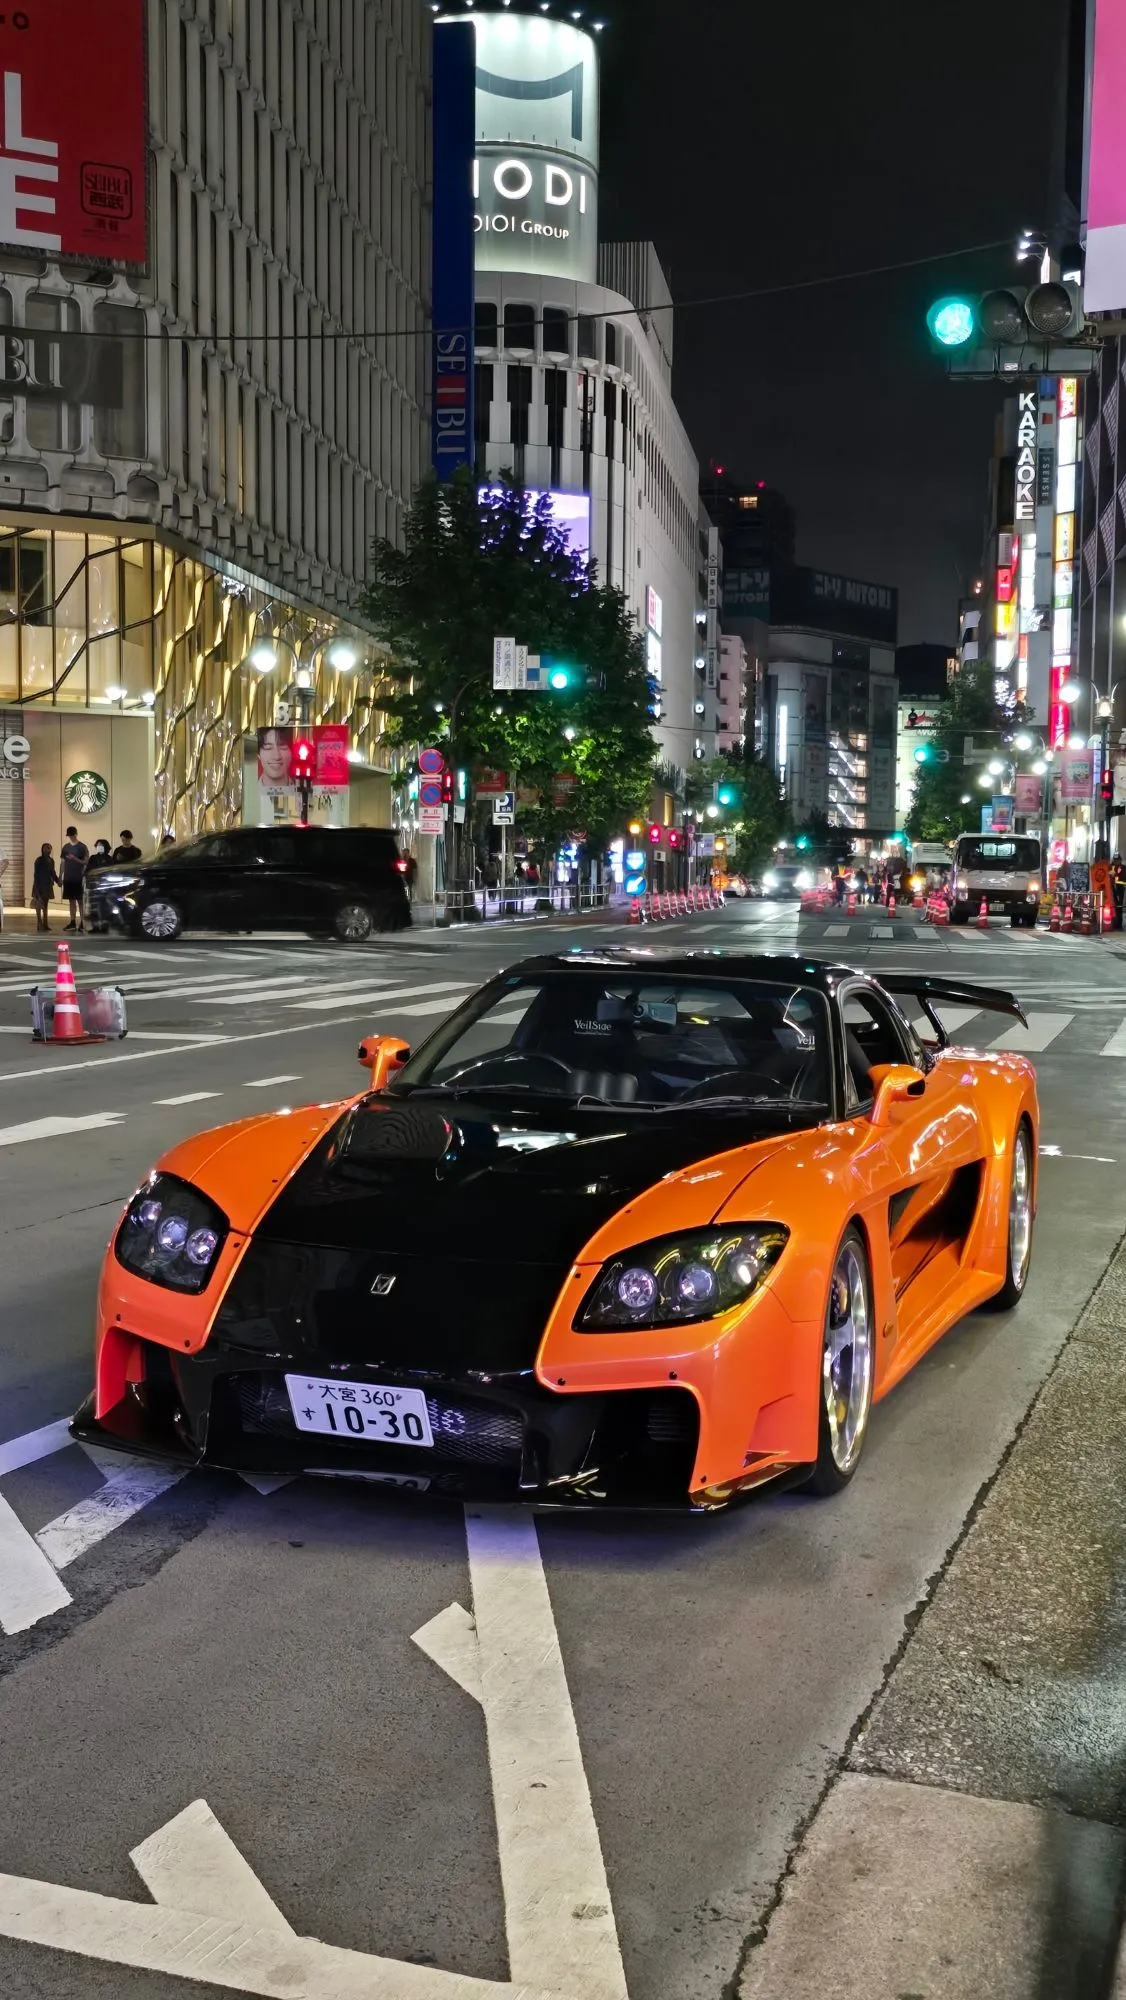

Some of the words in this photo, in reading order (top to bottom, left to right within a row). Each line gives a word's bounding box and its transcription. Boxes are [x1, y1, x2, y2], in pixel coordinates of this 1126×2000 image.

[85, 174, 128, 195] SEIBU
[474, 159, 586, 214] ODI
[520, 220, 570, 240] GROUP
[436, 333, 467, 455] SEIBU
[1014, 392, 1037, 520] KARAOKE
[574, 1018, 612, 1032] VeilSide
[302, 1407, 316, 1421] す
[326, 1403, 424, 1441] 10-30
